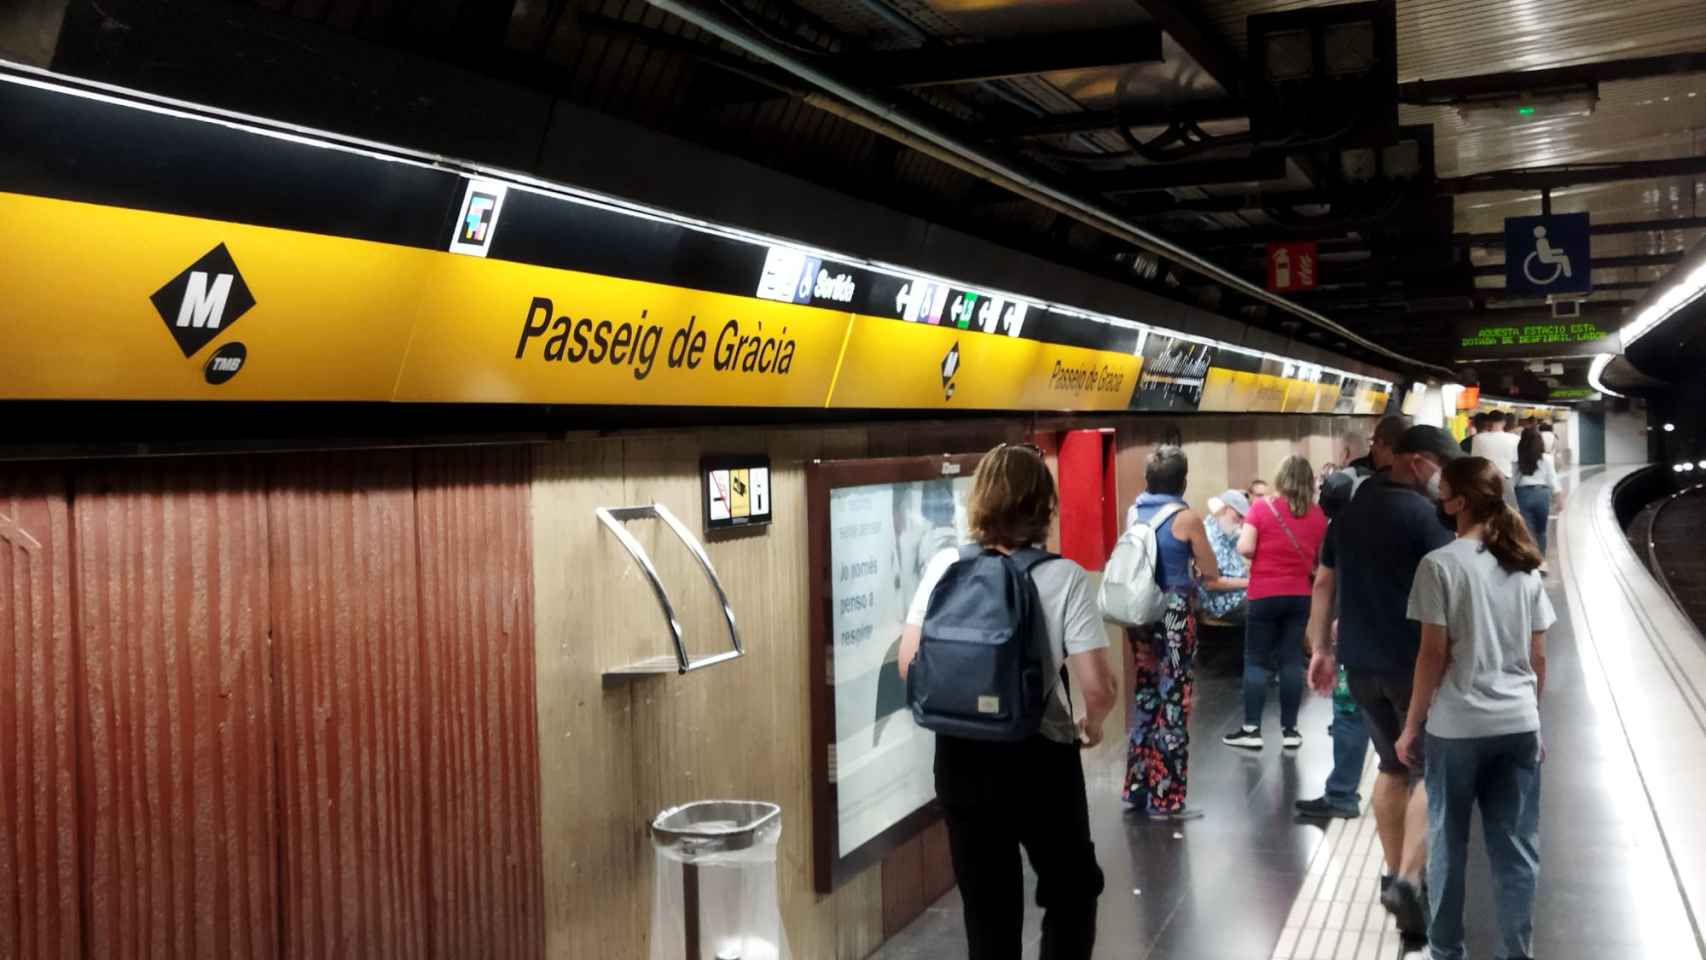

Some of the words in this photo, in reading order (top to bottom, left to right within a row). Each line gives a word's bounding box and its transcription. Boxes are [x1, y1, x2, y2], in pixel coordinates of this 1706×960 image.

[176, 271, 234, 329] M
[212, 357, 242, 371] TMB
[515, 296, 663, 380] Passeig
[668, 315, 706, 369] de
[713, 319, 796, 374] Gràcia
